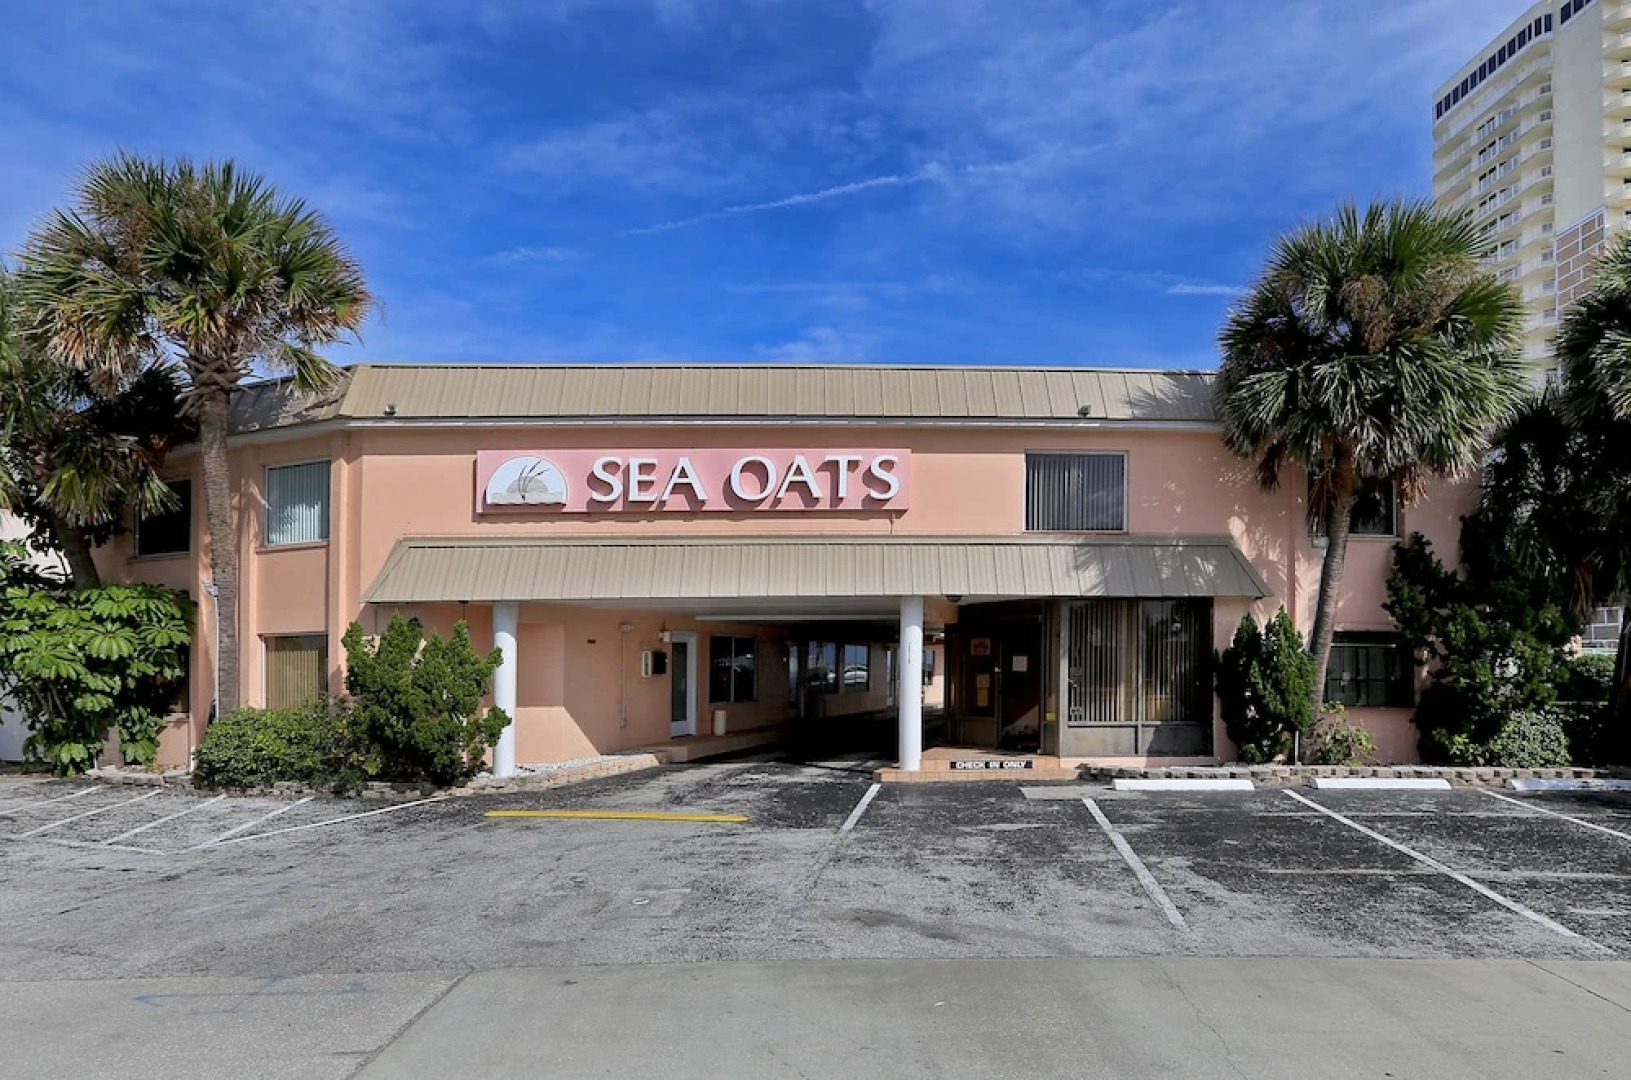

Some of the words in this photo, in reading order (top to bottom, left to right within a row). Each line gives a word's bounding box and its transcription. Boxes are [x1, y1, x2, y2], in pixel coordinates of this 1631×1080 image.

[591, 455, 709, 502] SEA
[730, 454, 900, 501] OATS
[955, 761, 985, 770] CHECK
[989, 761, 1000, 770] IN
[1002, 761, 1027, 770] ONLY
